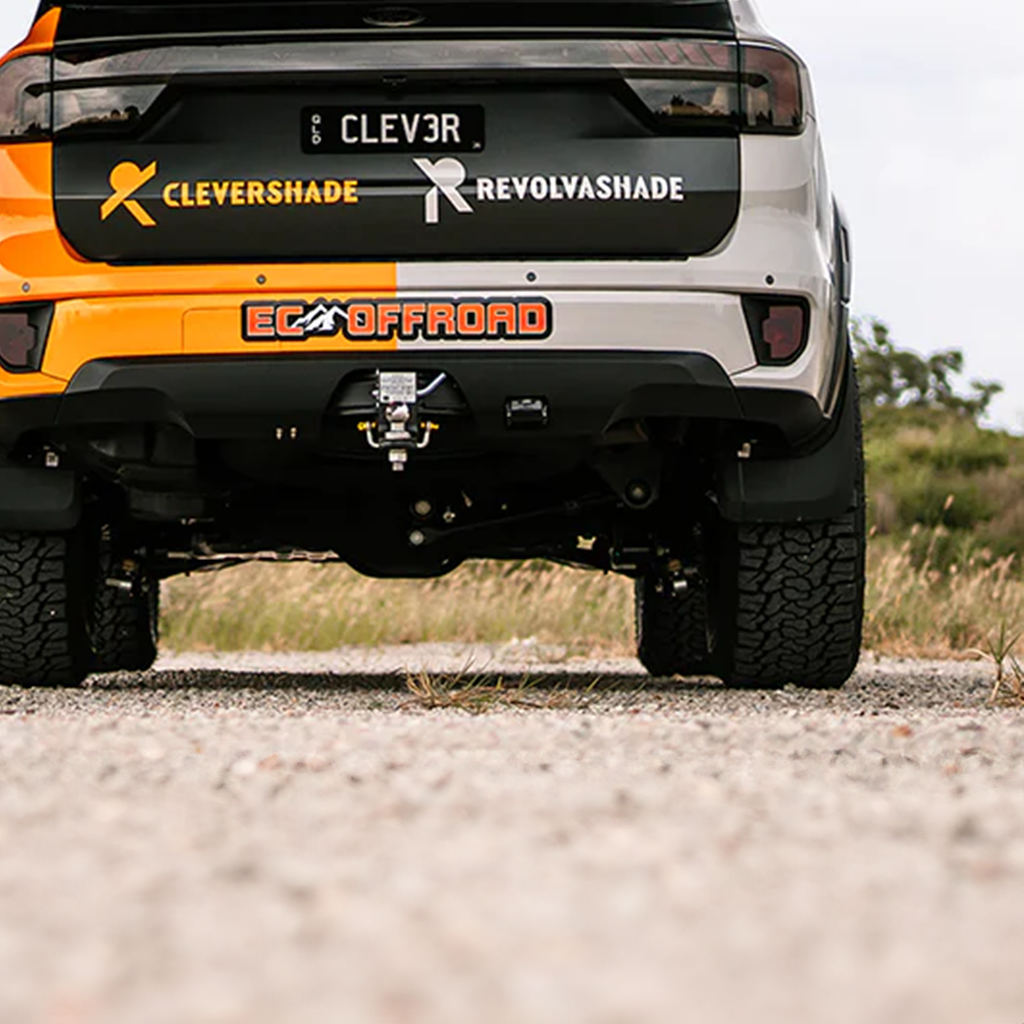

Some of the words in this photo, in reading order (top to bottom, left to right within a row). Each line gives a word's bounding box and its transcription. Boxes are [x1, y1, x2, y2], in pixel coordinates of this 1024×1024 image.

[311, 114, 322, 146] QLD
[340, 113, 462, 144] CLEV3R
[163, 180, 358, 207] CLEVERSHADE
[476, 176, 684, 201] REVOLVASHADE
